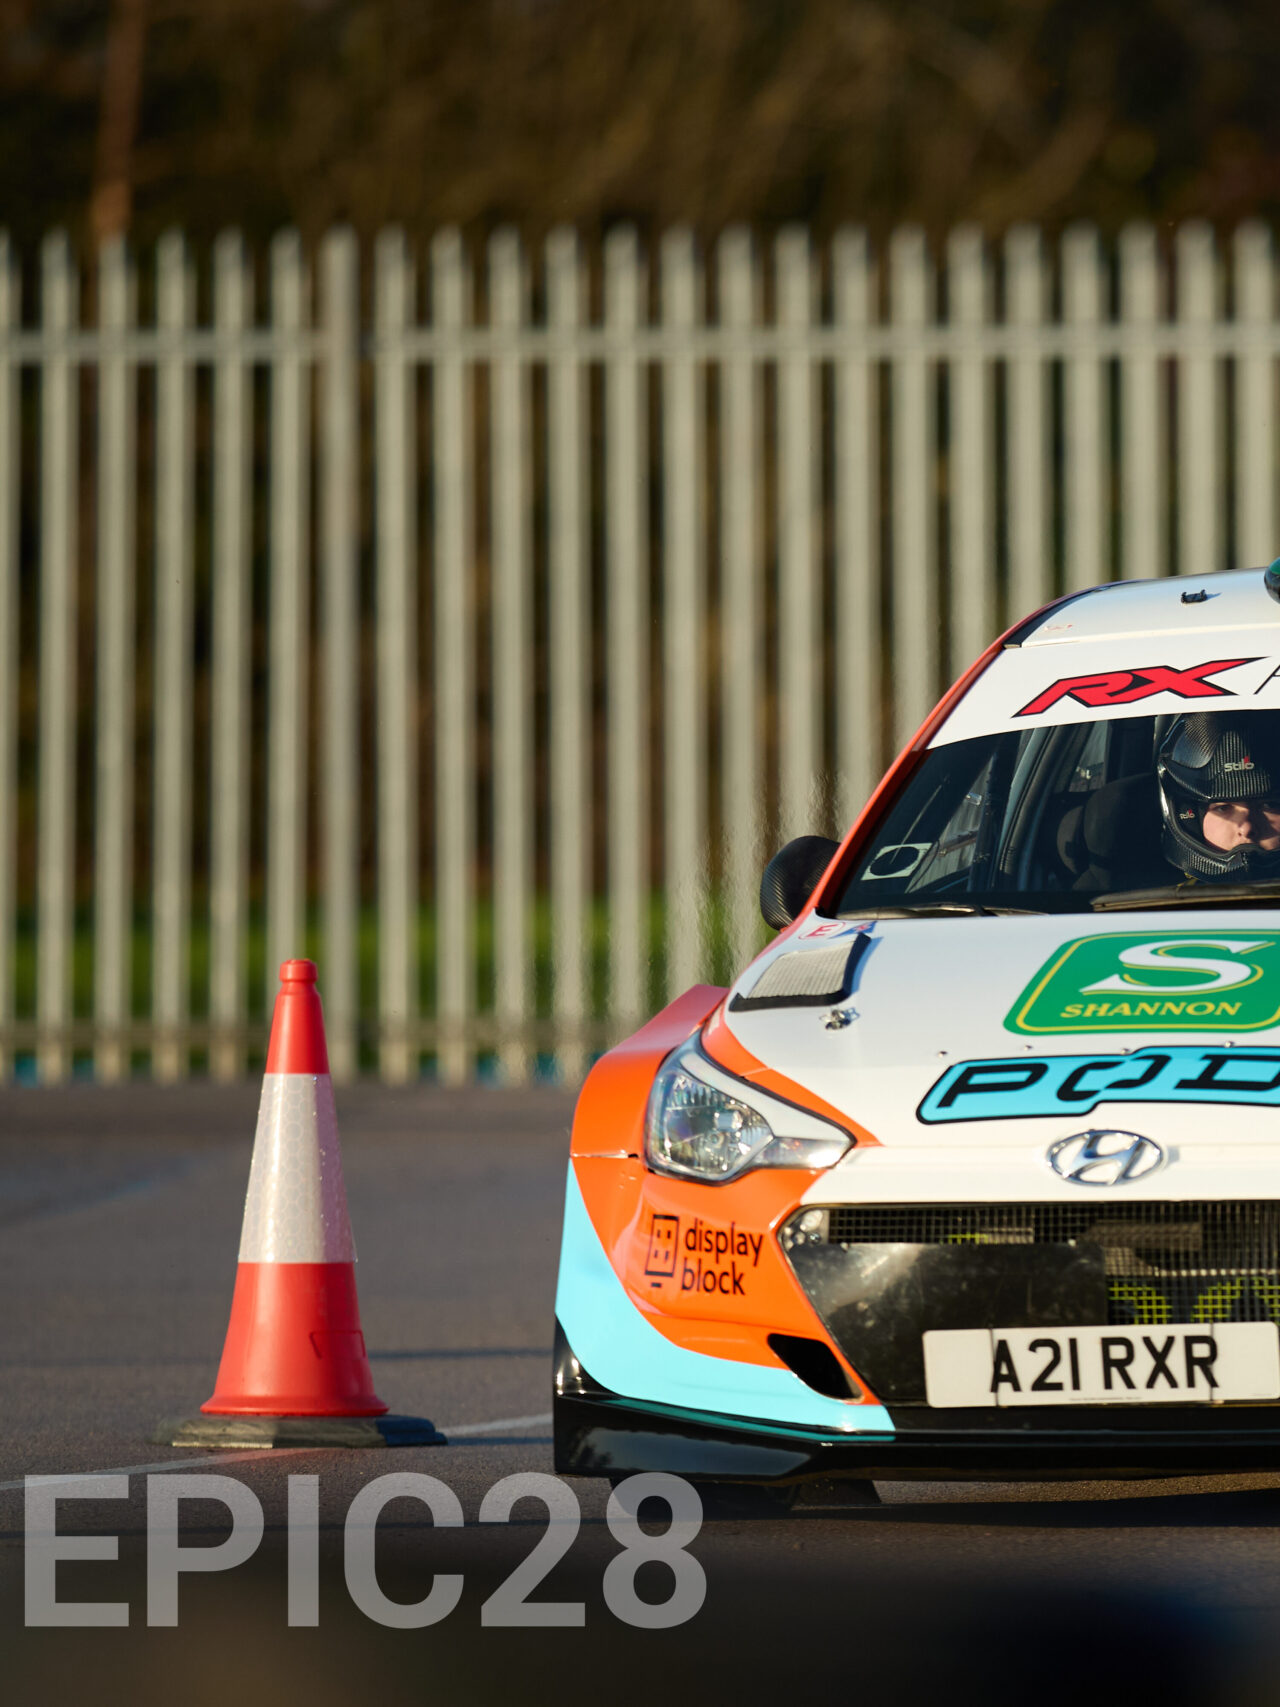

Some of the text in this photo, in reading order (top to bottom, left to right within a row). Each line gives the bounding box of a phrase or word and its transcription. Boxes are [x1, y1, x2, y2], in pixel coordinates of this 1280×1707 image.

[1010, 656, 1269, 718] RX
[1078, 939, 1275, 995] S
[1060, 1001, 1243, 1019] SHANNON
[685, 1217, 763, 1267] display
[681, 1256, 745, 1296] block
[990, 1335, 1220, 1393] A21 RXR
